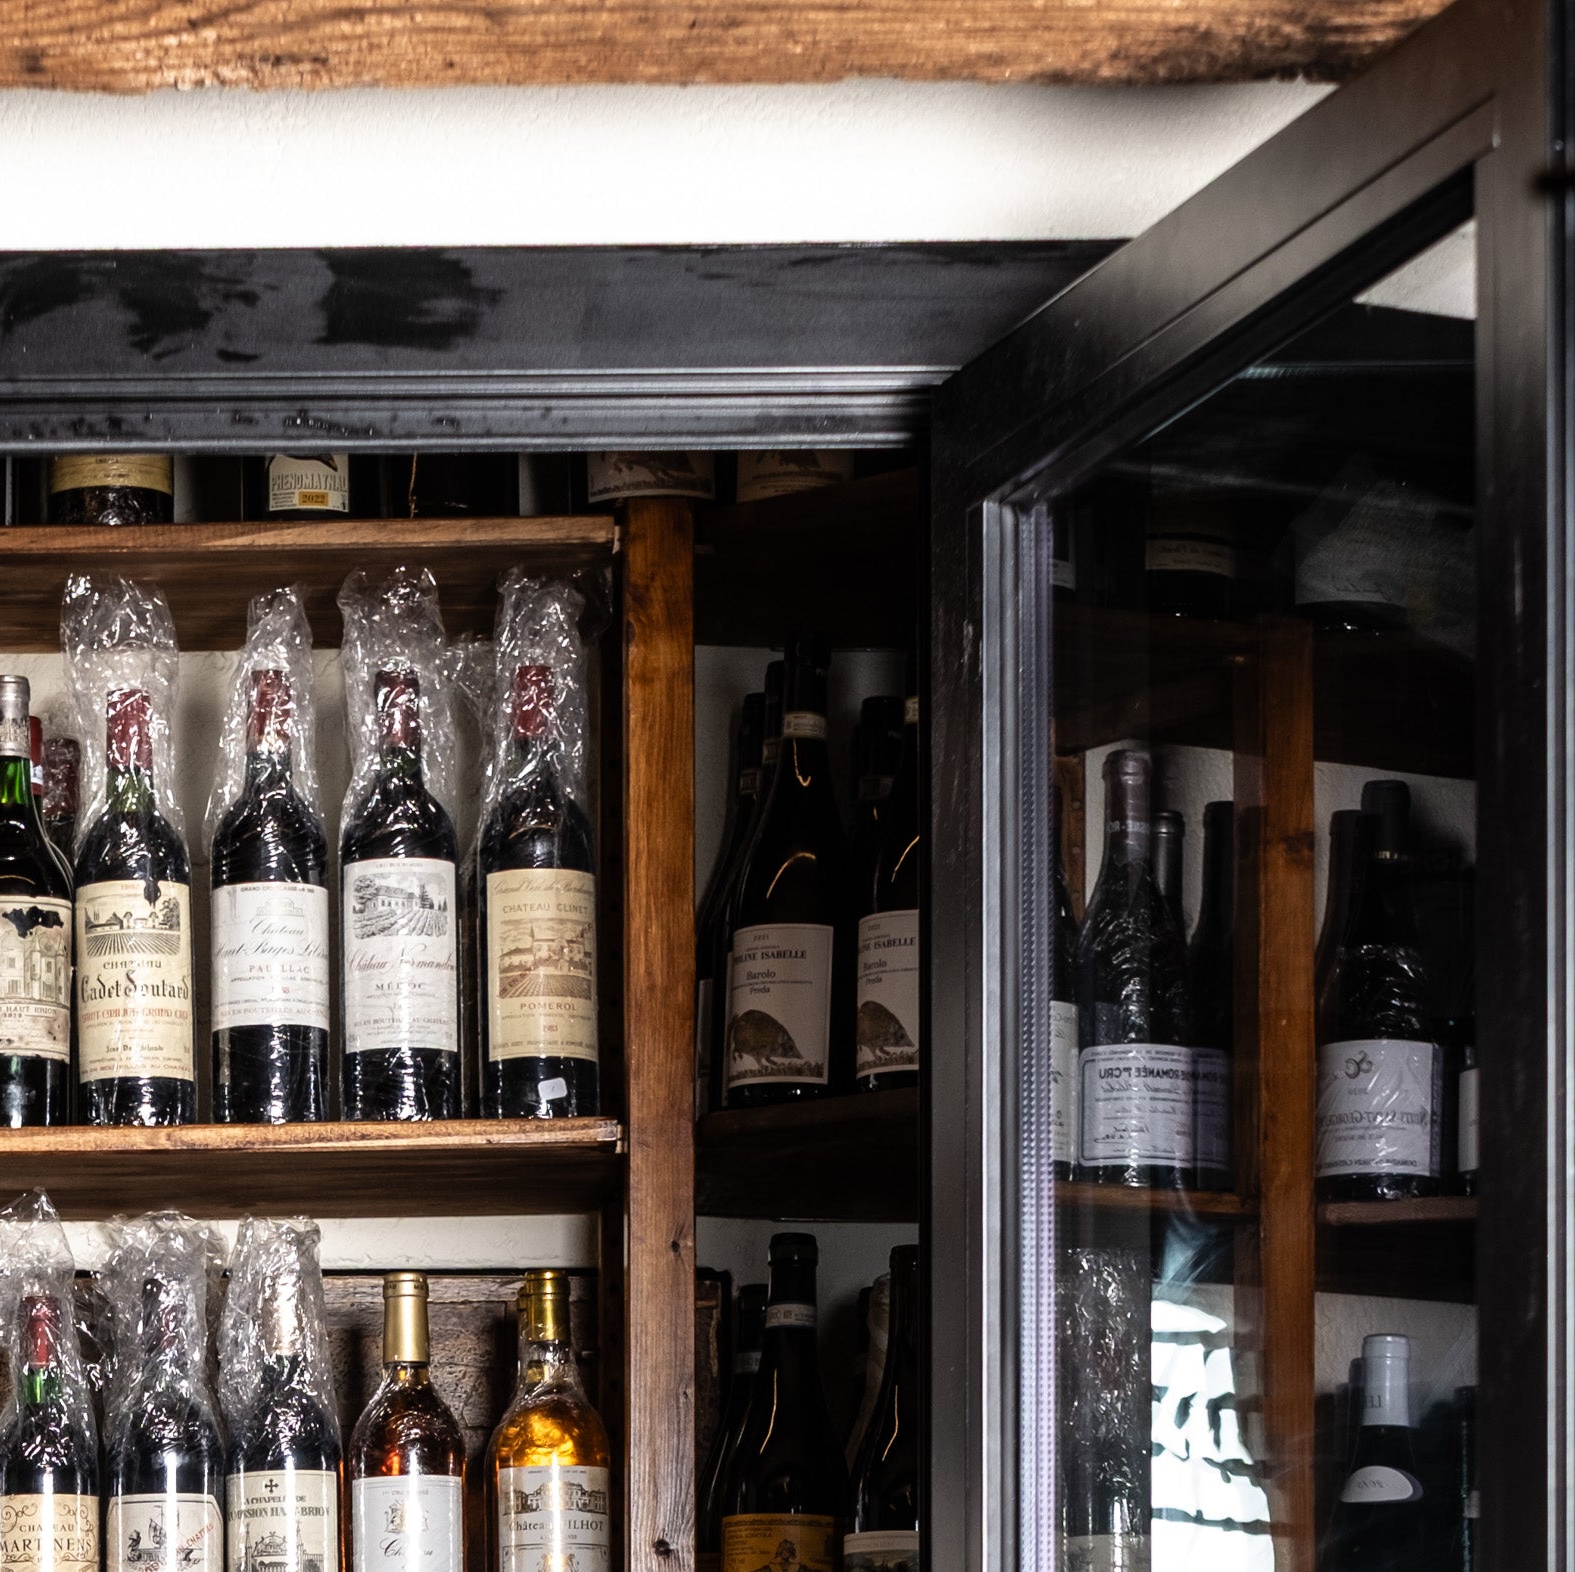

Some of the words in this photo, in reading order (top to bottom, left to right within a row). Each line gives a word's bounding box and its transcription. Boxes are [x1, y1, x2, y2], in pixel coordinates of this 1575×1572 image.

[874, 937, 916, 948] ISABELLE
[760, 951, 807, 960] ISABELLE
[863, 959, 887, 971] Barolo
[747, 970, 776, 980] Barolo
[0, 1538, 92, 1552] MARTNENS
